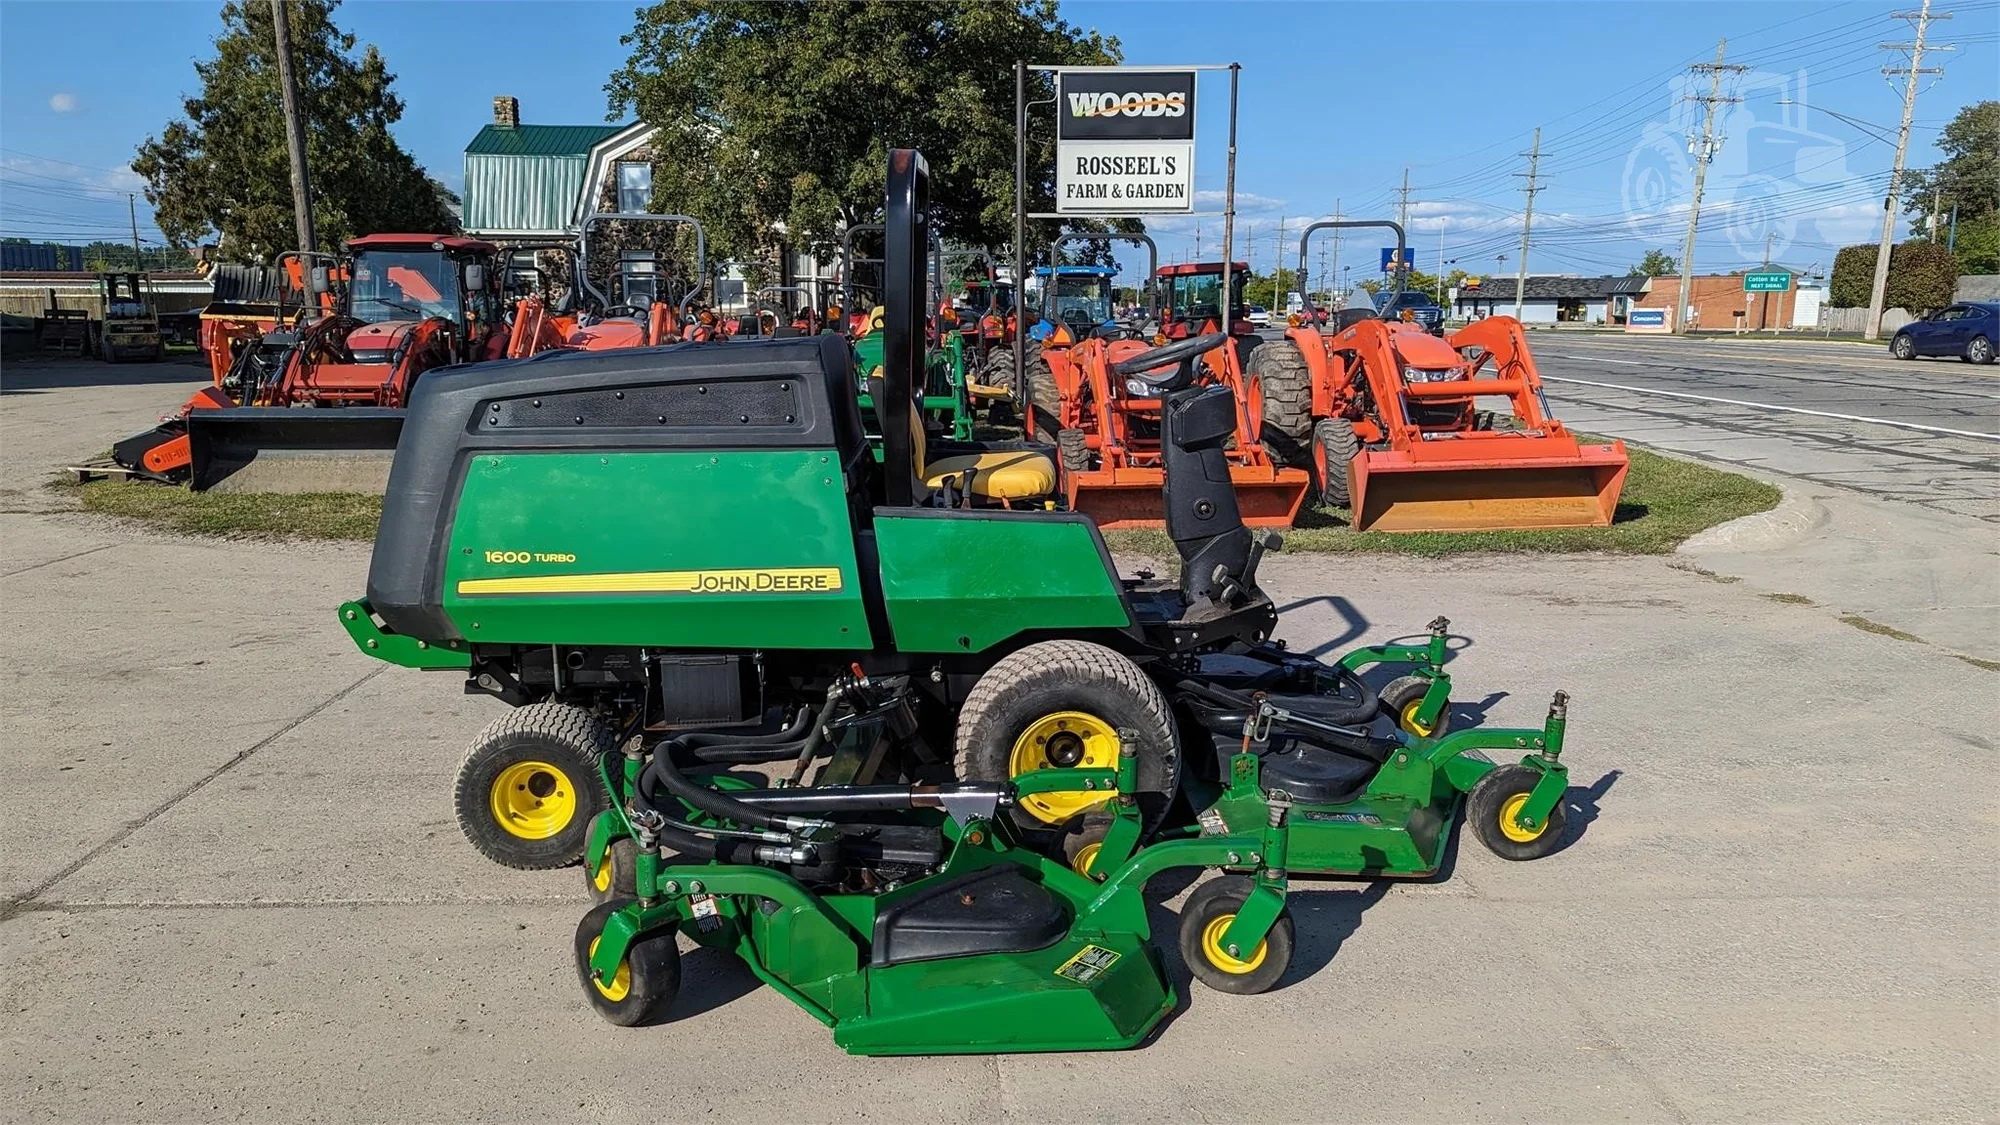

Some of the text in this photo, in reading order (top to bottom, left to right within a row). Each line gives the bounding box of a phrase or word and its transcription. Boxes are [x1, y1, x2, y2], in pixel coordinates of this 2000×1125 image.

[1067, 92, 1186, 117] WOODS
[1076, 156, 1176, 175] ROSSEEL'S
[1066, 183, 1185, 198] FARM & GARDEN
[484, 551, 576, 564] 1600 TURBO
[690, 572, 827, 590] JOHN DEERE
